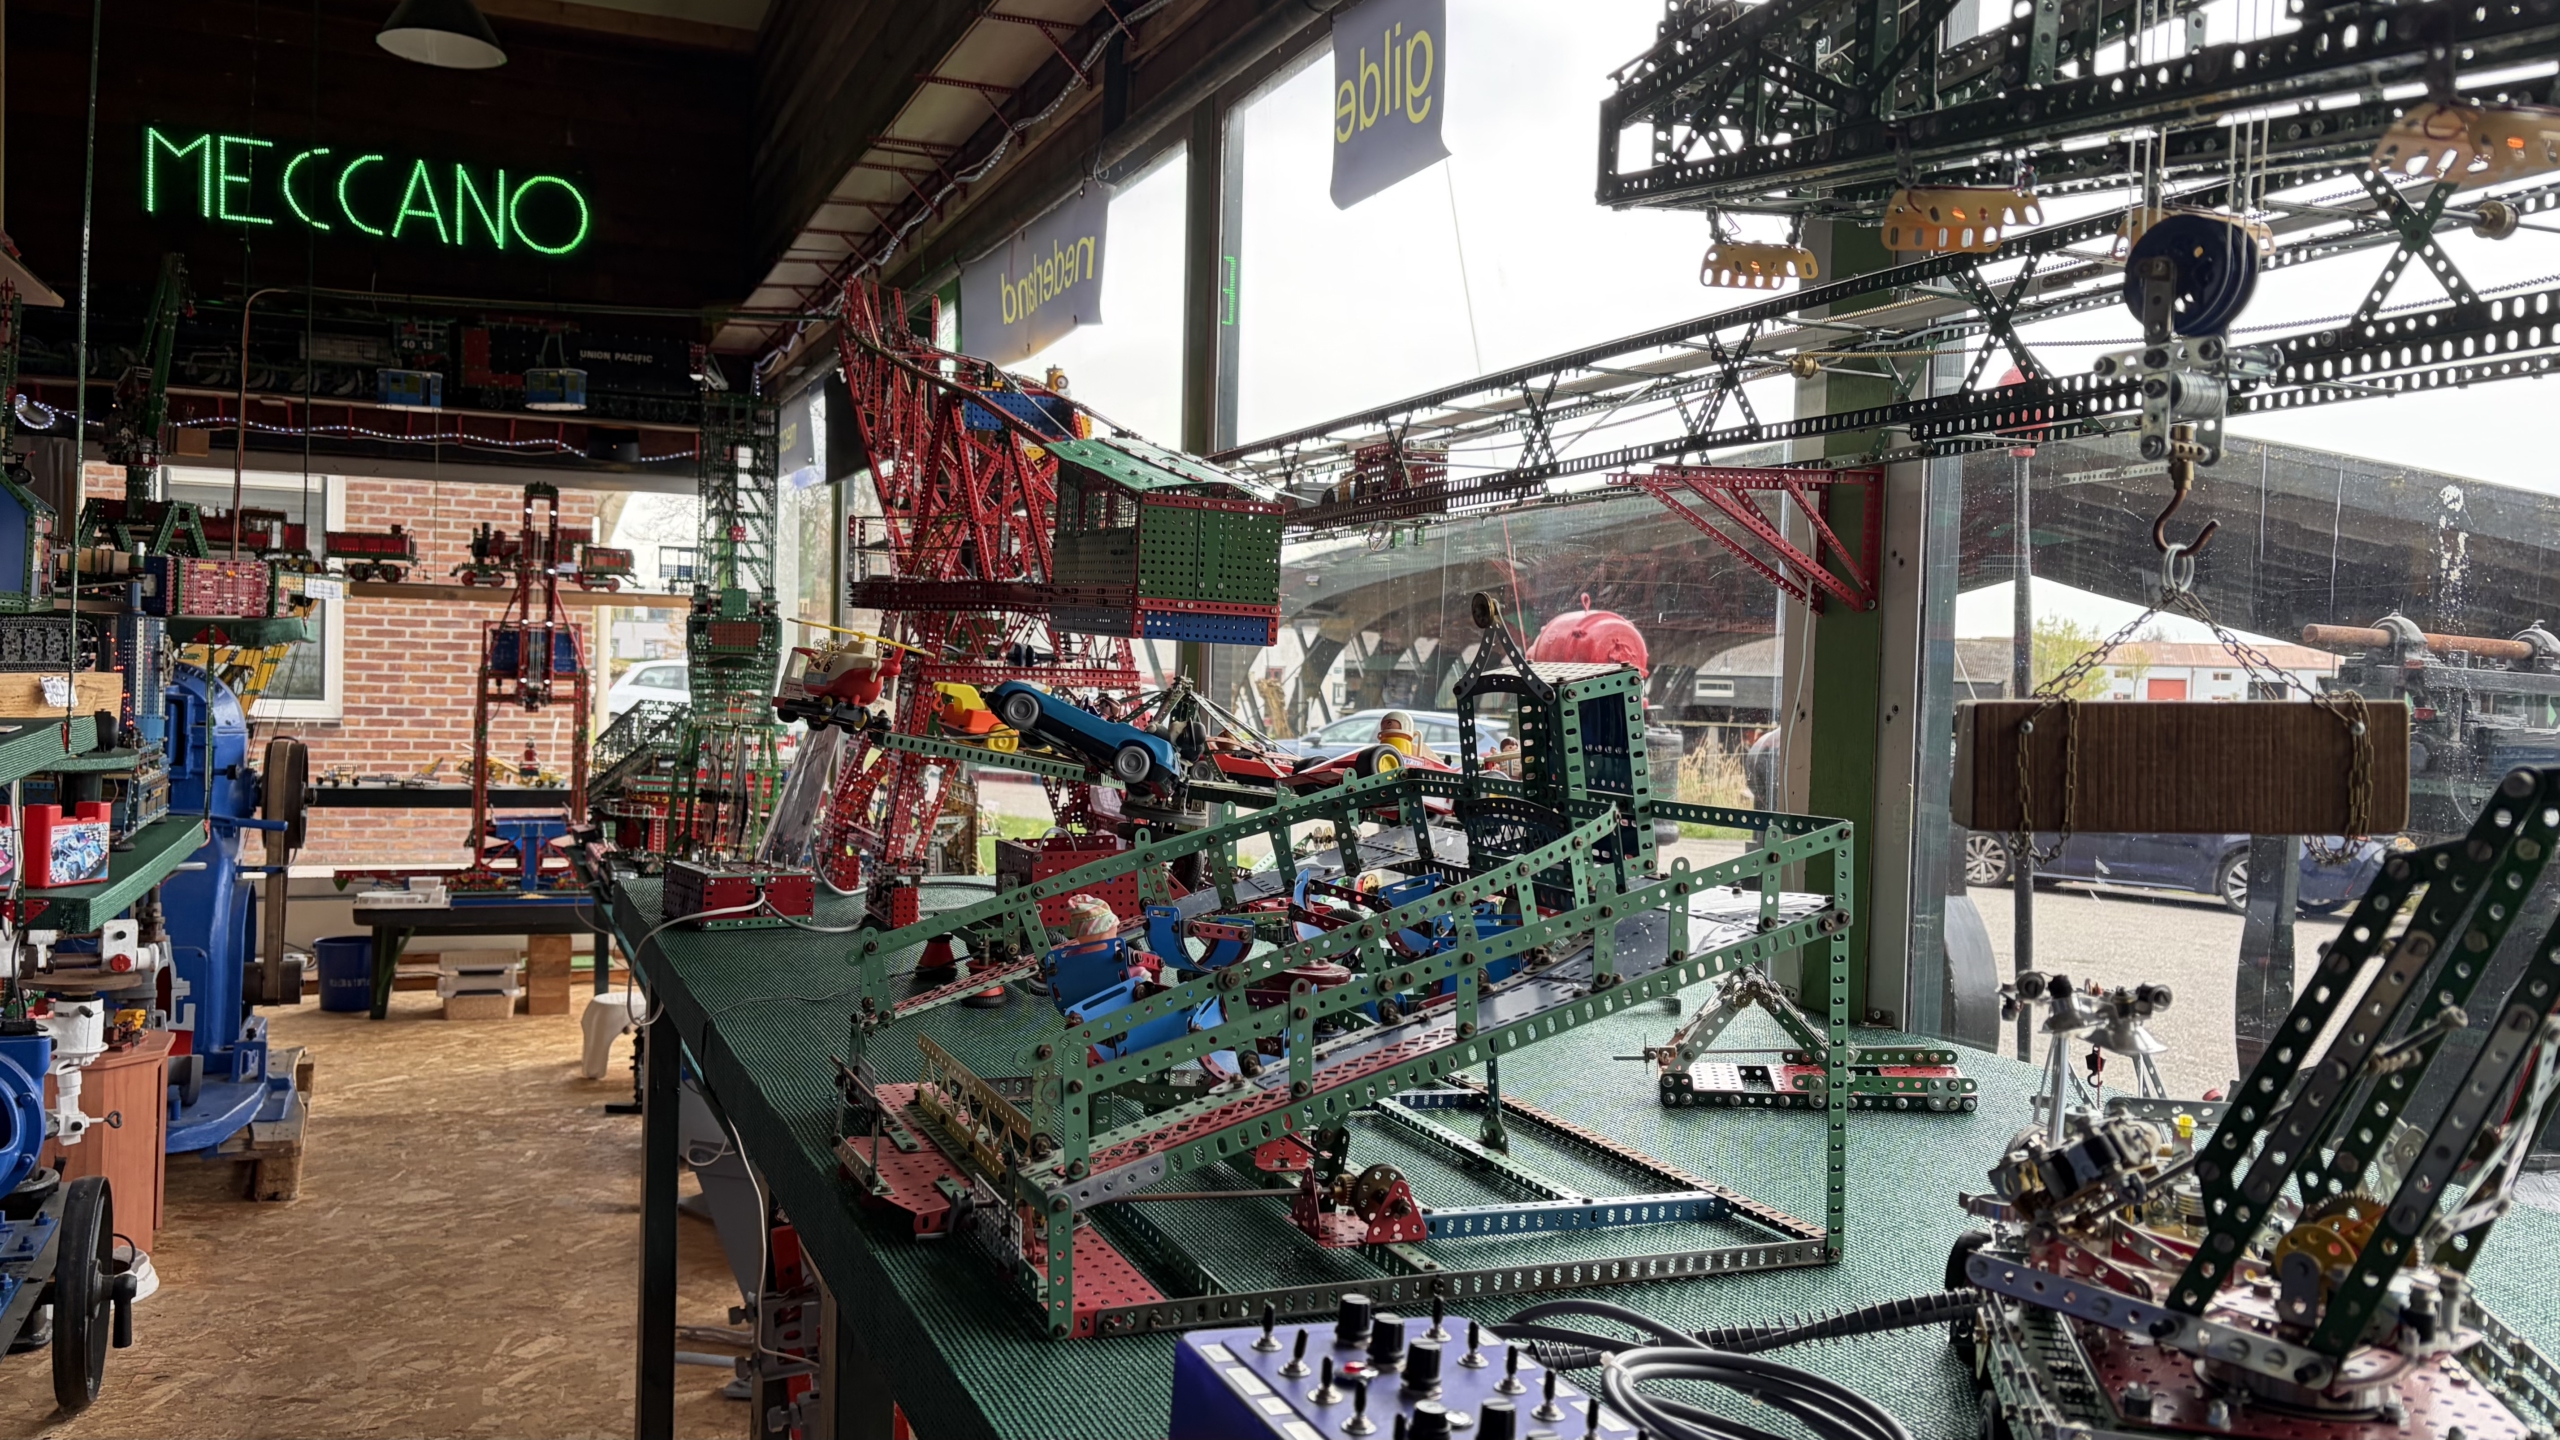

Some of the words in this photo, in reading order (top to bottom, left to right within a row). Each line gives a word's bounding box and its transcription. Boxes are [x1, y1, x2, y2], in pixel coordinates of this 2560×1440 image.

[146, 127, 589, 255] MECCANO
[579, 349, 611, 360] UNION
[614, 352, 653, 364] PACIFIC
